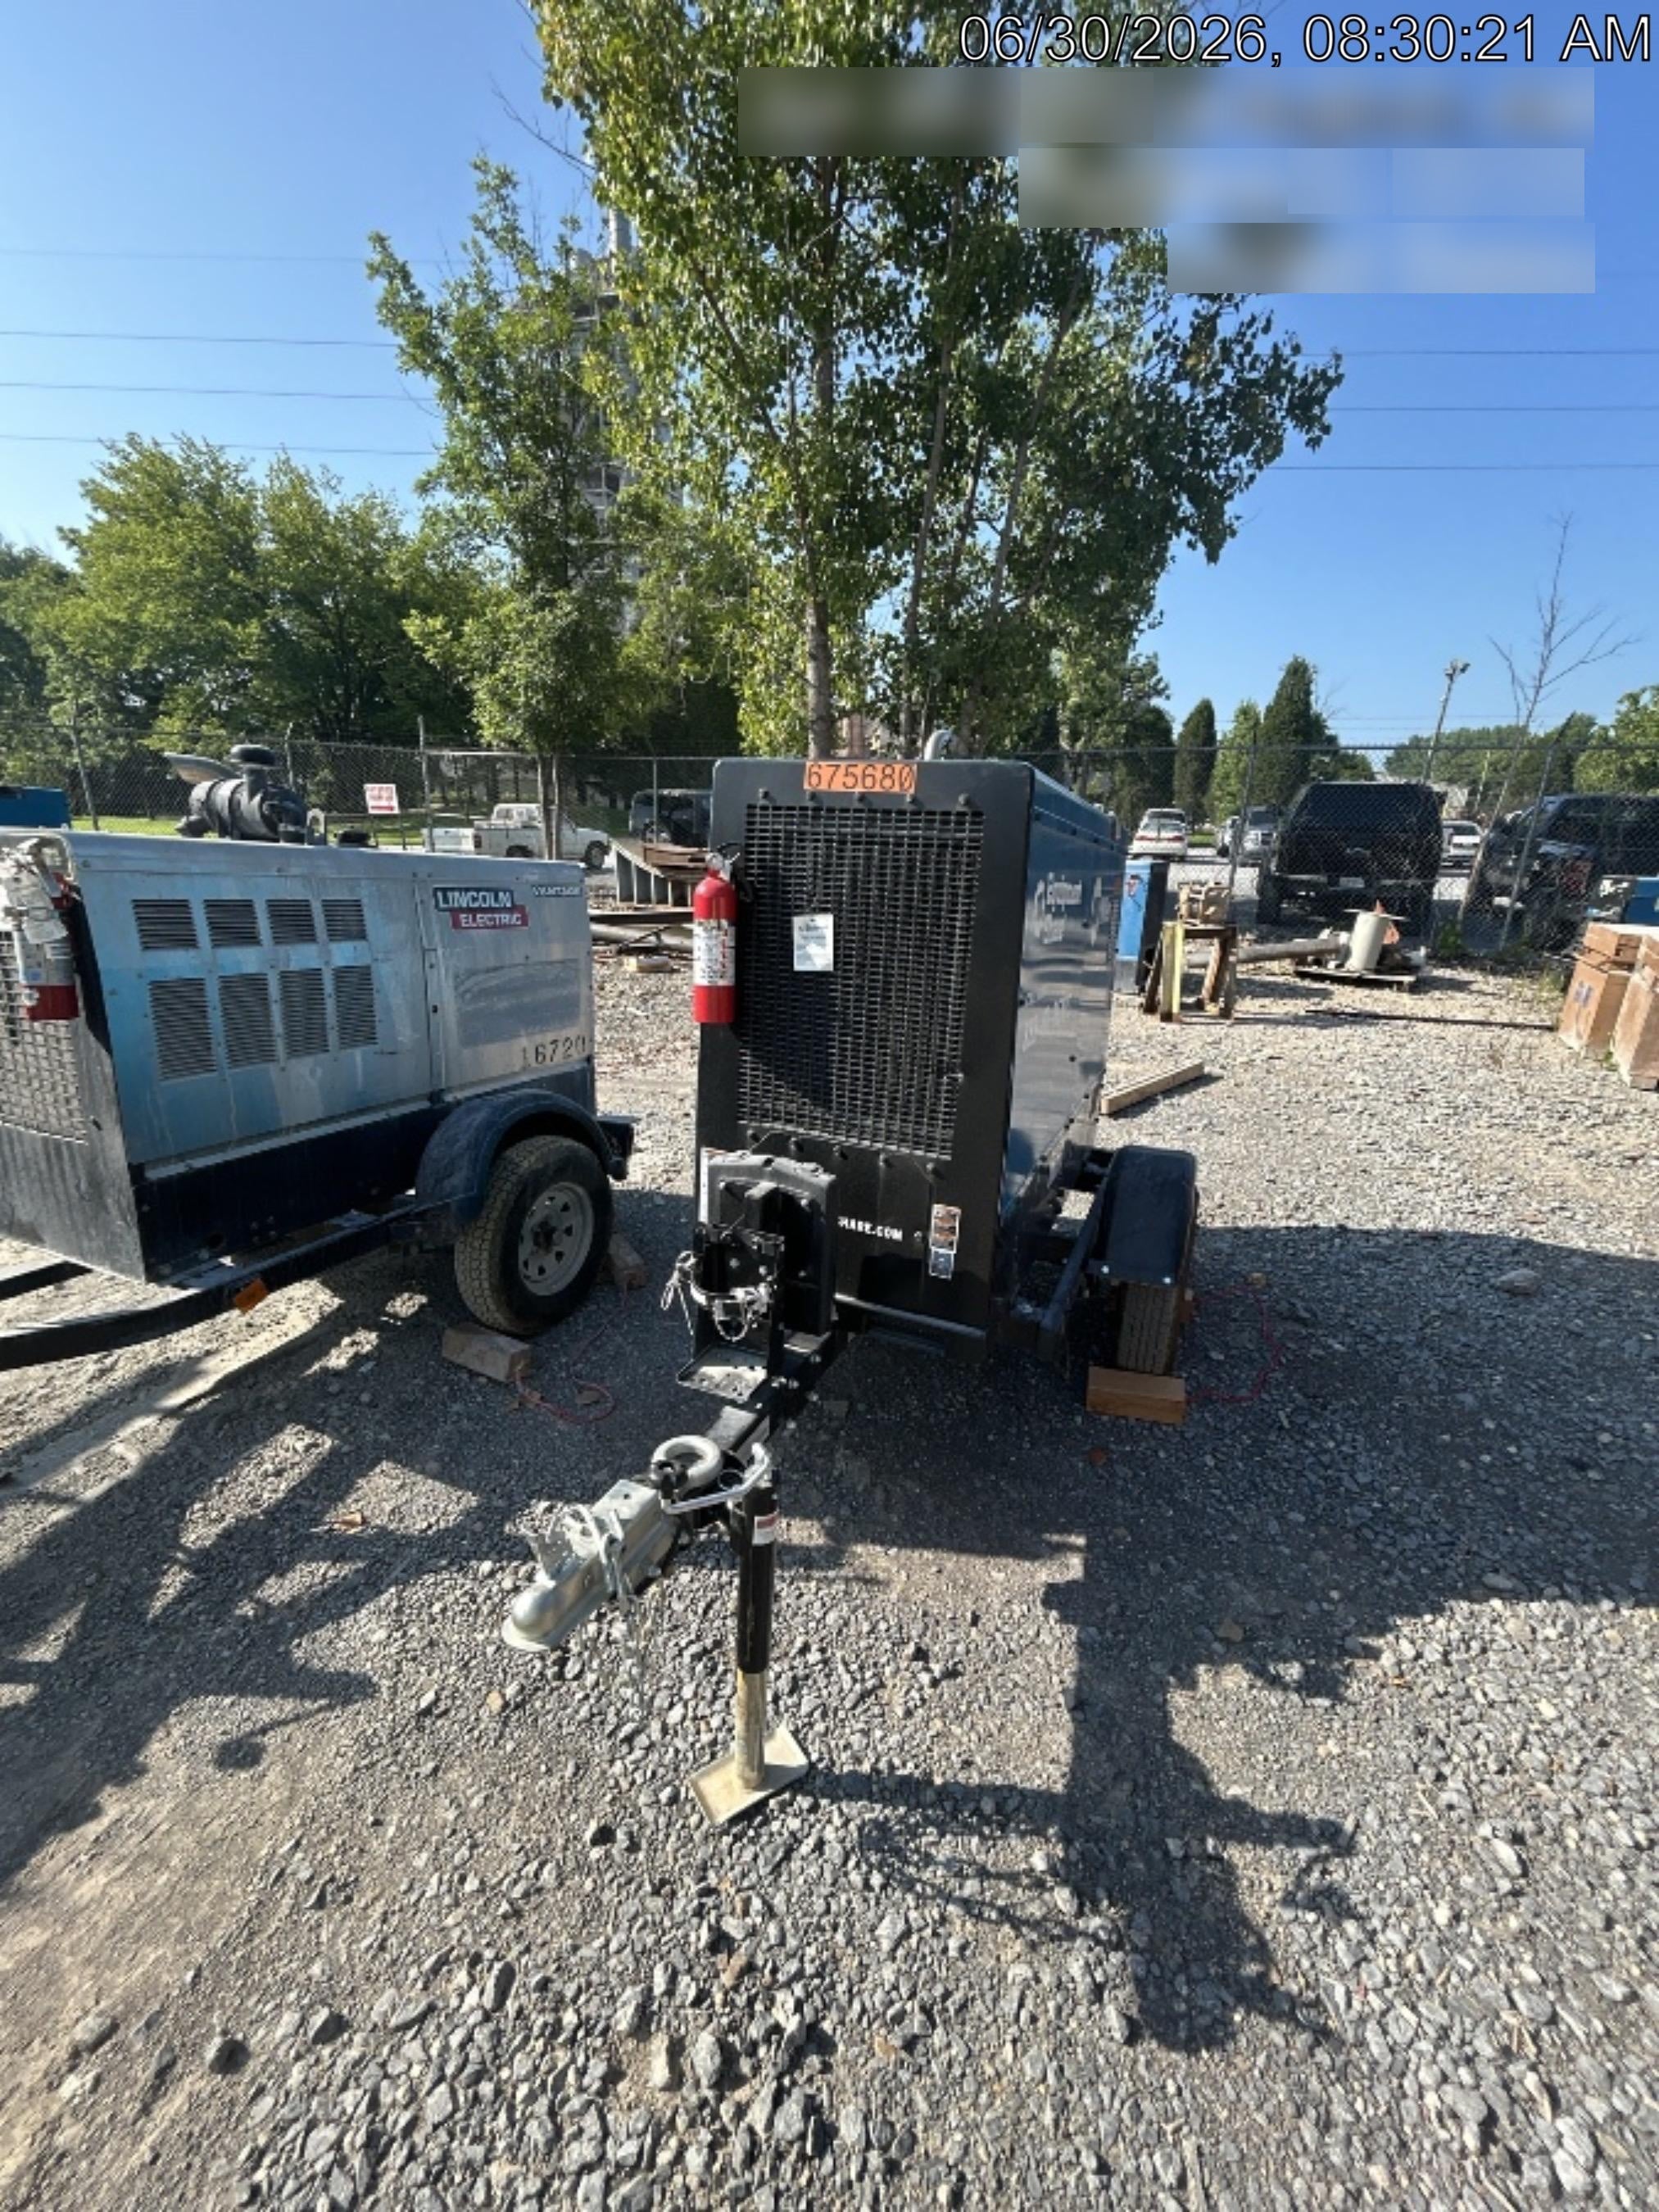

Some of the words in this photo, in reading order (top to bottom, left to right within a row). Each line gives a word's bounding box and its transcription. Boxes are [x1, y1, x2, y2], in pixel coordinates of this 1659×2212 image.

[807, 764, 915, 791] 675680
[437, 891, 513, 909] LINCOLN
[459, 913, 523, 927] ELECTRIC
